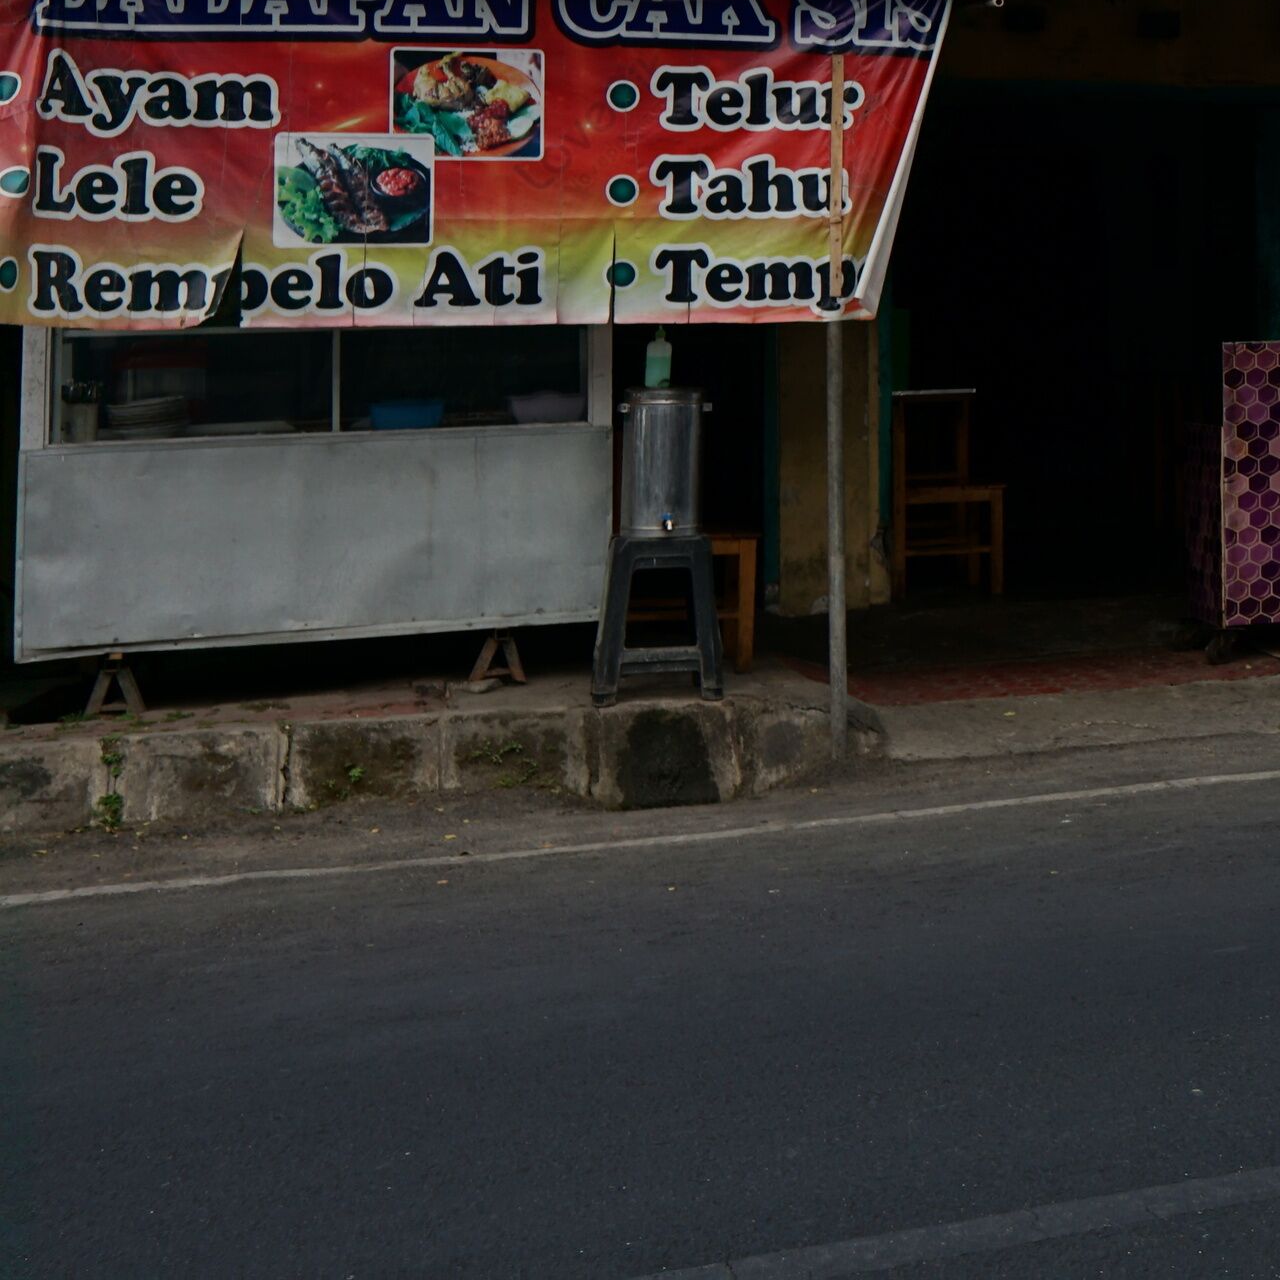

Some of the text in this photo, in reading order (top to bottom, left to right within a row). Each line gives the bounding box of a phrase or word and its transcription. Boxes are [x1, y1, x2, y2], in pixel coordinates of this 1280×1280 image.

[38, 51, 278, 135] Ayam
[653, 68, 863, 129] Telur
[34, 148, 202, 219] Lele
[653, 156, 849, 217] Tahu
[413, 248, 544, 310] Ati
[653, 246, 866, 314] Temp
